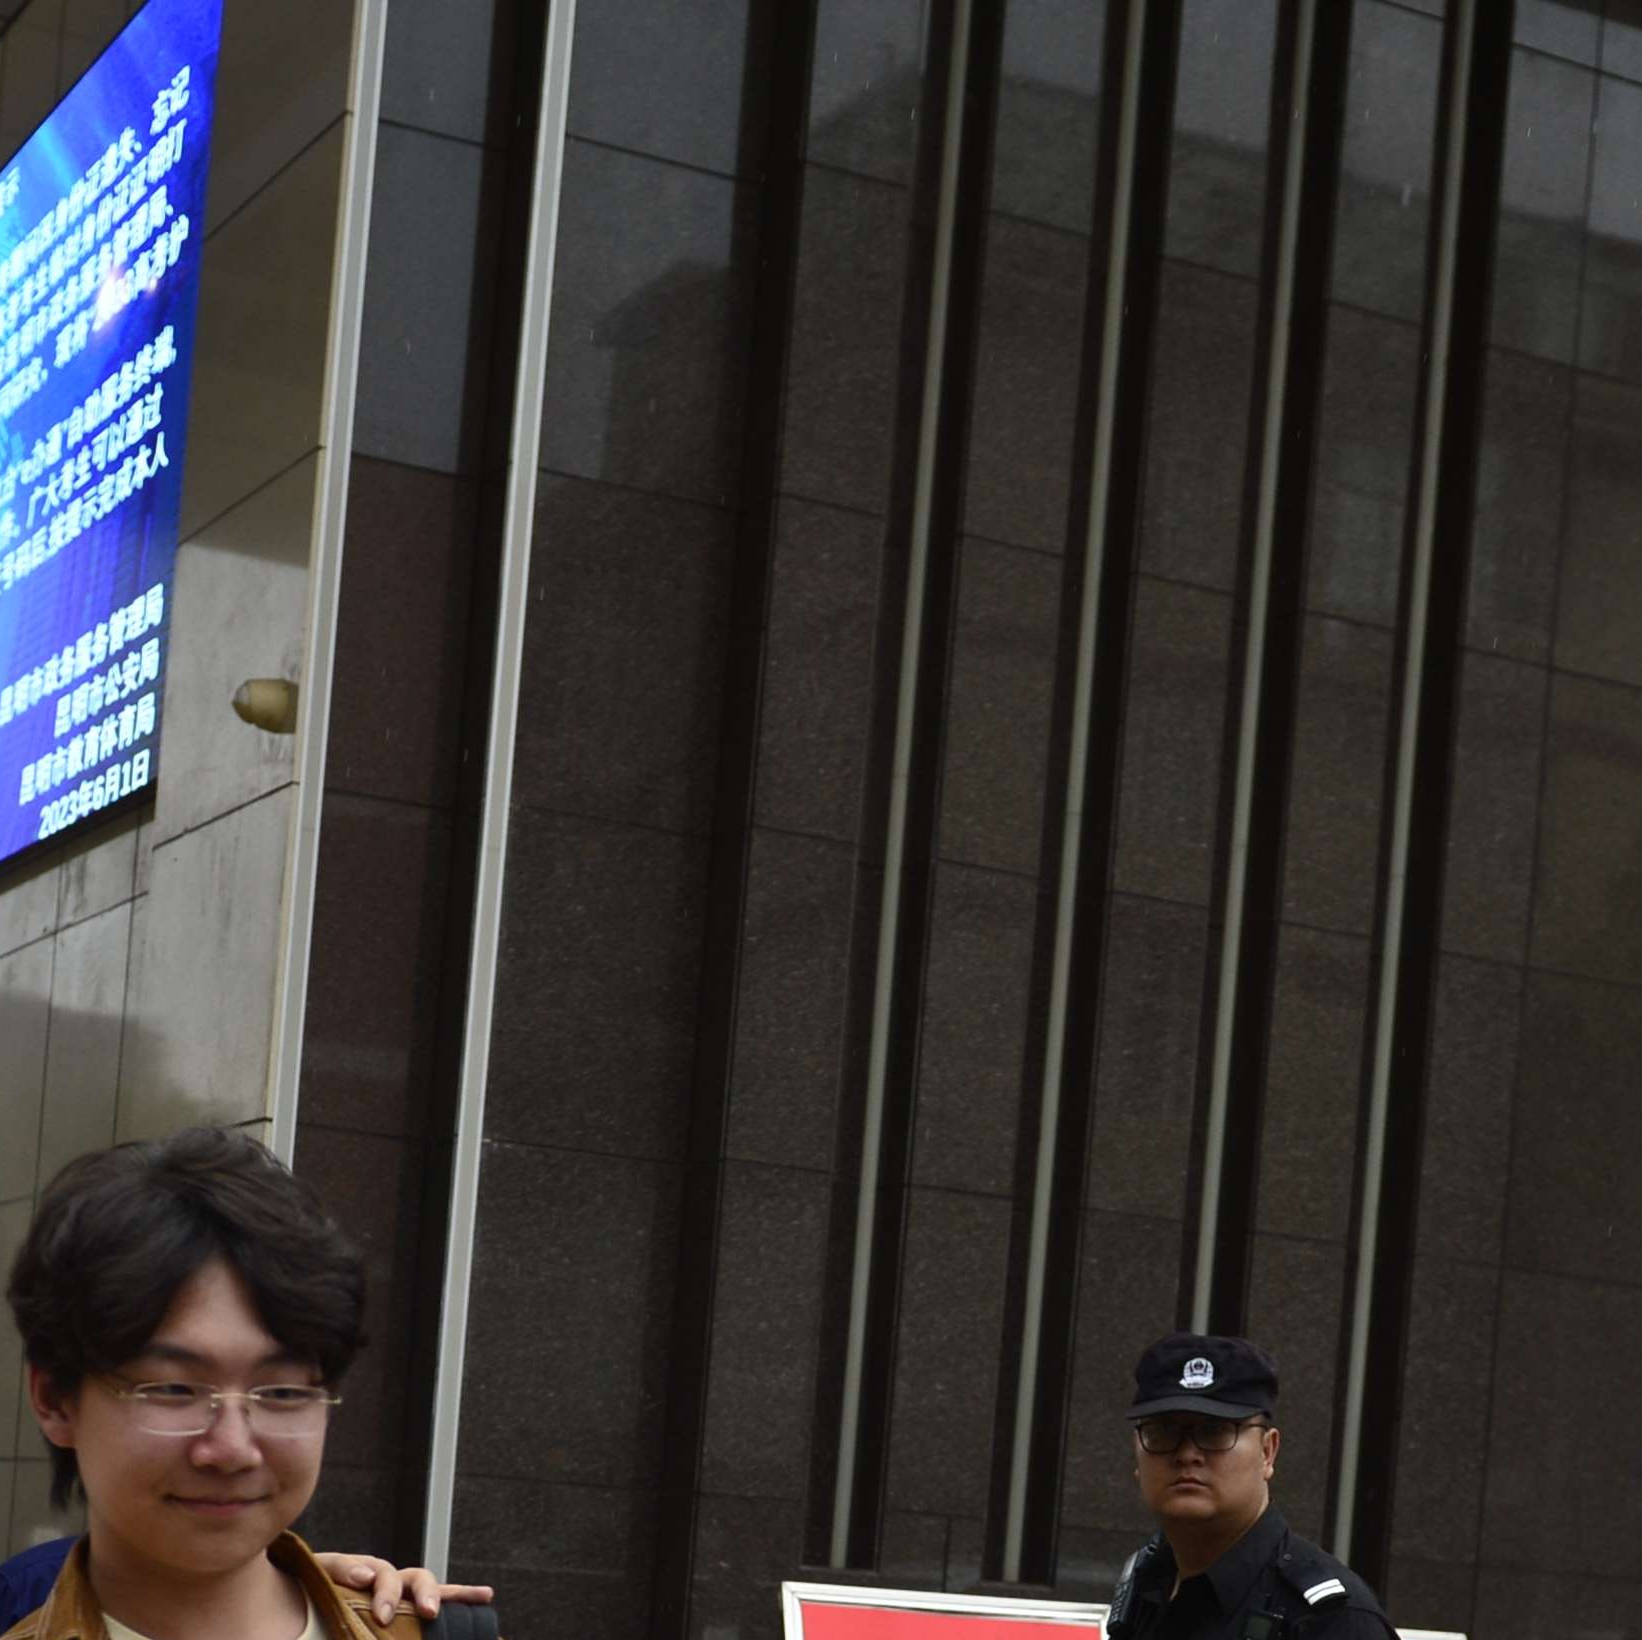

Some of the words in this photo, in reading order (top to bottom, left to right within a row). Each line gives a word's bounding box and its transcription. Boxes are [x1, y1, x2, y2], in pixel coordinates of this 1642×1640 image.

[54, 637, 160, 738] 昆明市公安局
[19, 693, 156, 805] 昆明市教育体育局
[37, 749, 151, 840] 2023年6月1日
